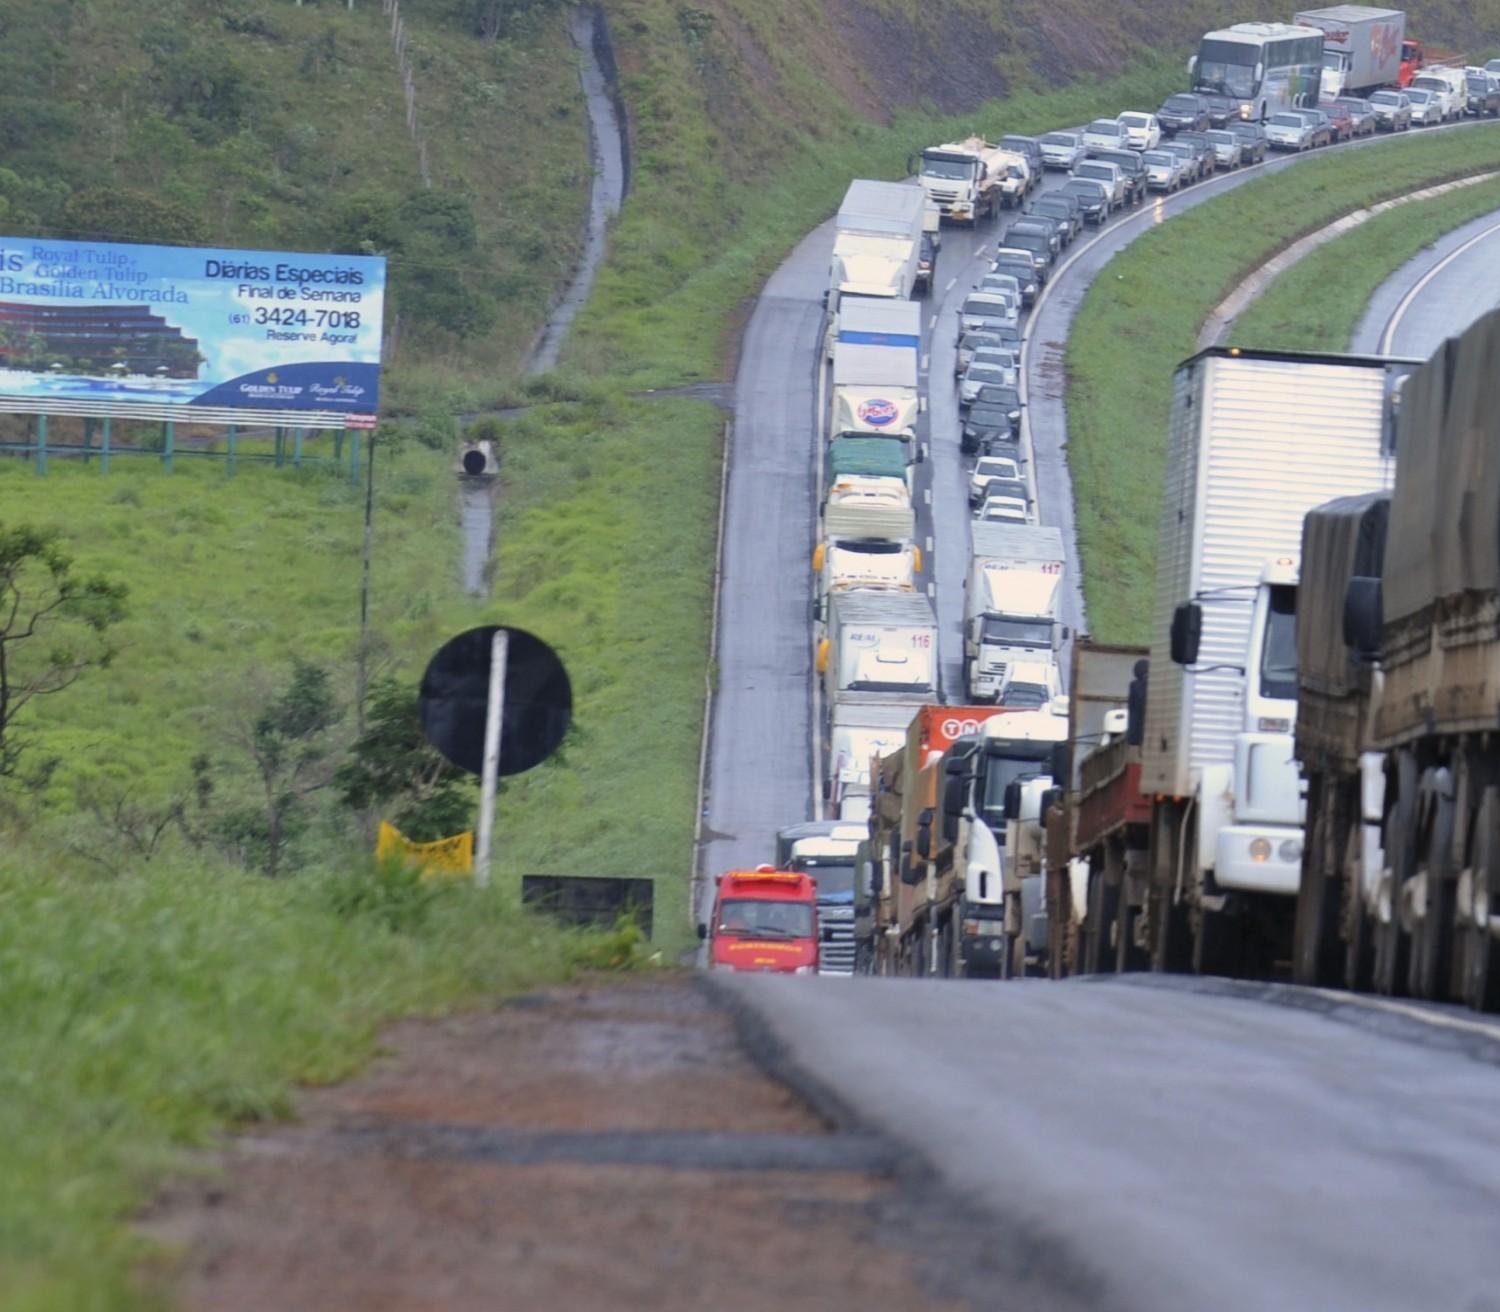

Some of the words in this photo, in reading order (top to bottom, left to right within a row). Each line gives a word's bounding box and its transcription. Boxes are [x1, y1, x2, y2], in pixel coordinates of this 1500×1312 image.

[32, 246, 79, 267] Royal
[86, 249, 128, 270] Tulip
[34, 263, 98, 280] Golden
[104, 267, 148, 285] Tulip
[205, 260, 270, 281] Diárias
[276, 264, 364, 287] Especiais
[92, 282, 189, 304] Alvorada
[238, 284, 273, 299] Final
[277, 287, 296, 300] de
[301, 287, 361, 303] Semana
[228, 313, 250, 325] (61)
[255, 306, 360, 329] 3424-7018
[266, 329, 317, 342] Reserve
[320, 332, 357, 346] Agora!
[1041, 564, 1061, 575] 117
[912, 635, 931, 649] 116
